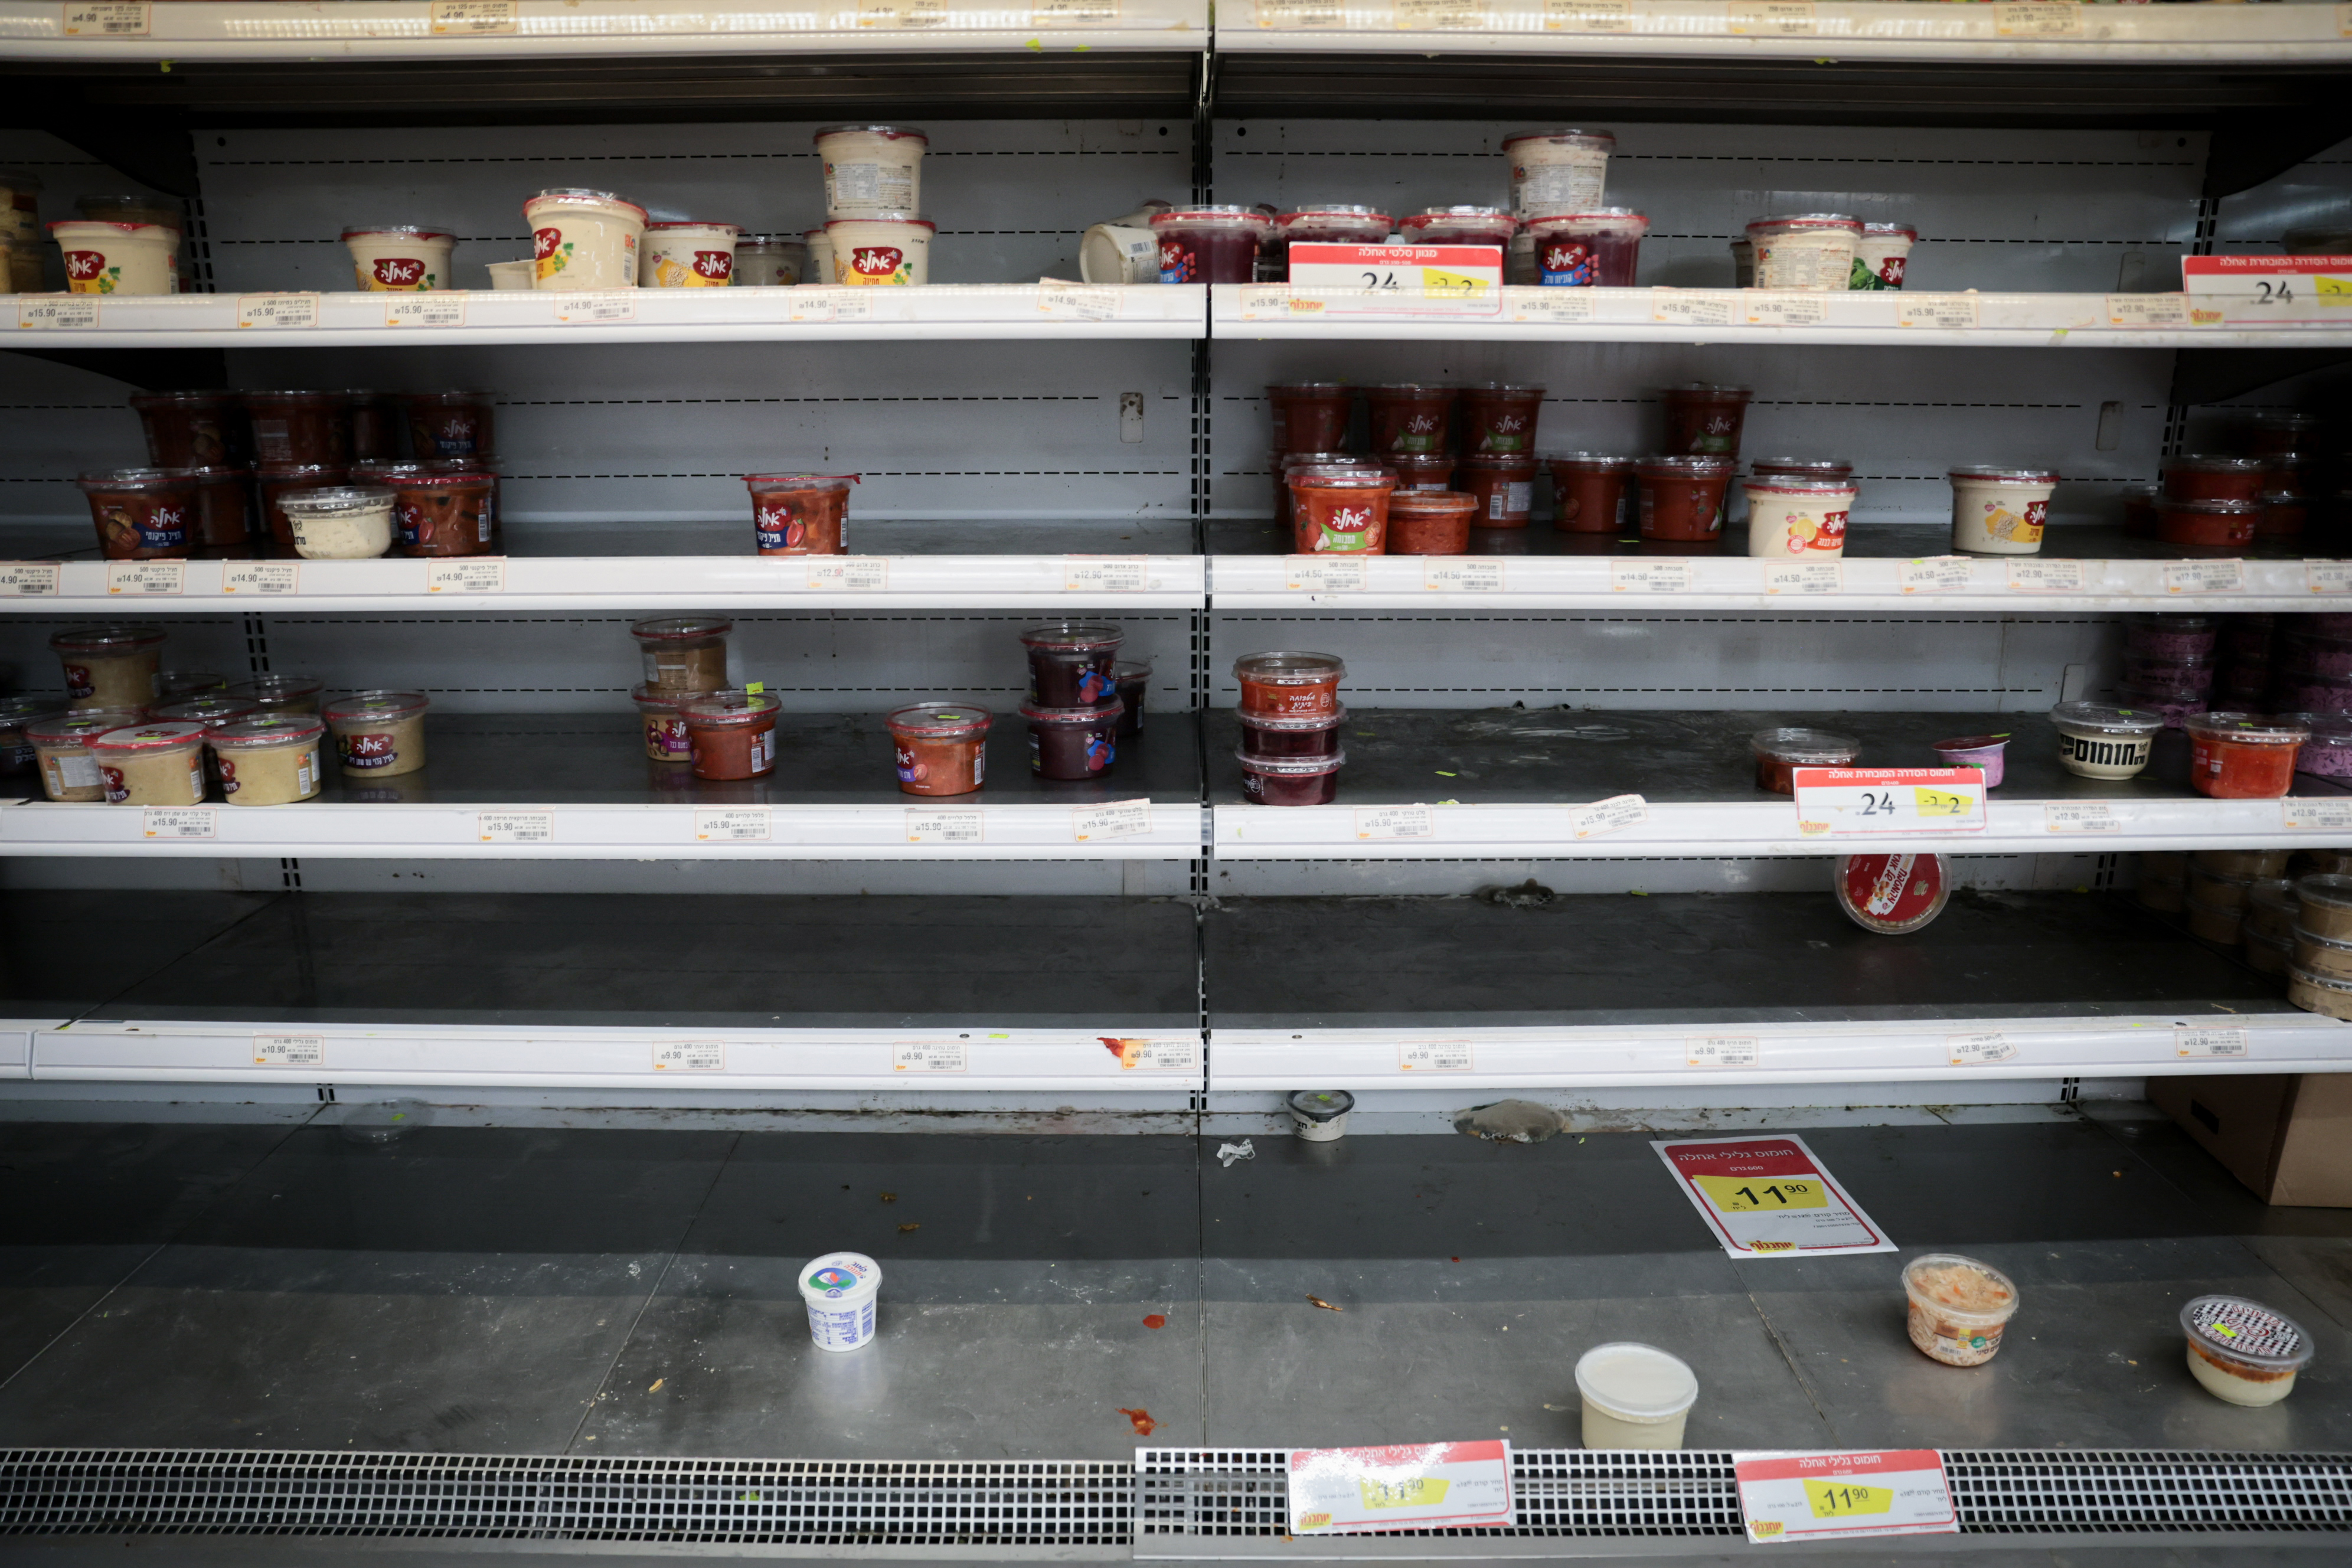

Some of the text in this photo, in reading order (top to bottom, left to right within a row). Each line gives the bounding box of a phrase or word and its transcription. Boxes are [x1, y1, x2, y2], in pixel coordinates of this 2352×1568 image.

[72, 14, 96, 22] ₪4.90
[1358, 247, 1437, 258] מגוון סלטי אחלה
[701, 253, 726, 275] אחלה
[859, 250, 890, 272] אחלה
[1547, 248, 1574, 270] אחלה
[2220, 257, 2246, 267] אחלה
[2249, 257, 2293, 267] המובחרת
[2295, 257, 2327, 266] הסדרה
[381, 261, 412, 282] אחלה
[1361, 272, 1400, 296] 24
[2256, 280, 2293, 305] 24
[799, 300, 827, 309] ₪14.90
[1048, 295, 1076, 306] ₪14.90
[1250, 298, 1278, 308] ₪15.90
[395, 305, 422, 314] ₪15.90
[564, 301, 592, 311] ₪14.90
[1522, 302, 1549, 311] ₪15.90
[1662, 303, 1690, 314] ₪15.90
[1755, 303, 1782, 313] ₪15.90
[2117, 305, 2144, 313] ₪12.90
[28, 308, 55, 317] ₪15.90
[247, 308, 275, 318] ₪15.90
[1907, 308, 1934, 316] ₪15.90
[1496, 415, 1521, 433] אחלה
[151, 508, 180, 528] אחלה
[757, 507, 780, 528] אחלה
[1332, 508, 1364, 530] אחלה
[117, 574, 143, 583] ₪14.90
[231, 574, 257, 583] ₪14.90
[436, 572, 463, 582] ₪14.90
[817, 569, 844, 578] ₪12.90
[1074, 570, 1102, 580] ₪12.90
[1295, 570, 1322, 579] ₪14.50
[1433, 571, 1461, 580] ₪14.50
[1621, 573, 1647, 582] ₪14.50
[1774, 574, 1800, 583] ₪14.50
[1909, 570, 1935, 581] ₪14.50
[2016, 570, 2042, 578] ₪12.90
[2175, 573, 2201, 582] ₪12.90
[2317, 573, 2343, 582] ₪12.90
[1289, 692, 1315, 702] מטבוחה
[357, 737, 383, 756] אחלה
[2075, 739, 2136, 766] חומוס
[1828, 769, 1955, 779] חומוס הסדרה המובחרת אחלה
[1861, 792, 1896, 816] 24
[1949, 798, 1961, 814] 2
[1082, 818, 1108, 829] ₪15.90
[1366, 819, 1391, 828] ₪15.90
[1580, 812, 1606, 826] ₪15.90
[1956, 1044, 1979, 1053] ₪12.90
[1677, 1148, 1794, 1162] חומוס גלילי אחלה
[1799, 1455, 1881, 1468] חומוס גלילי אחלה
